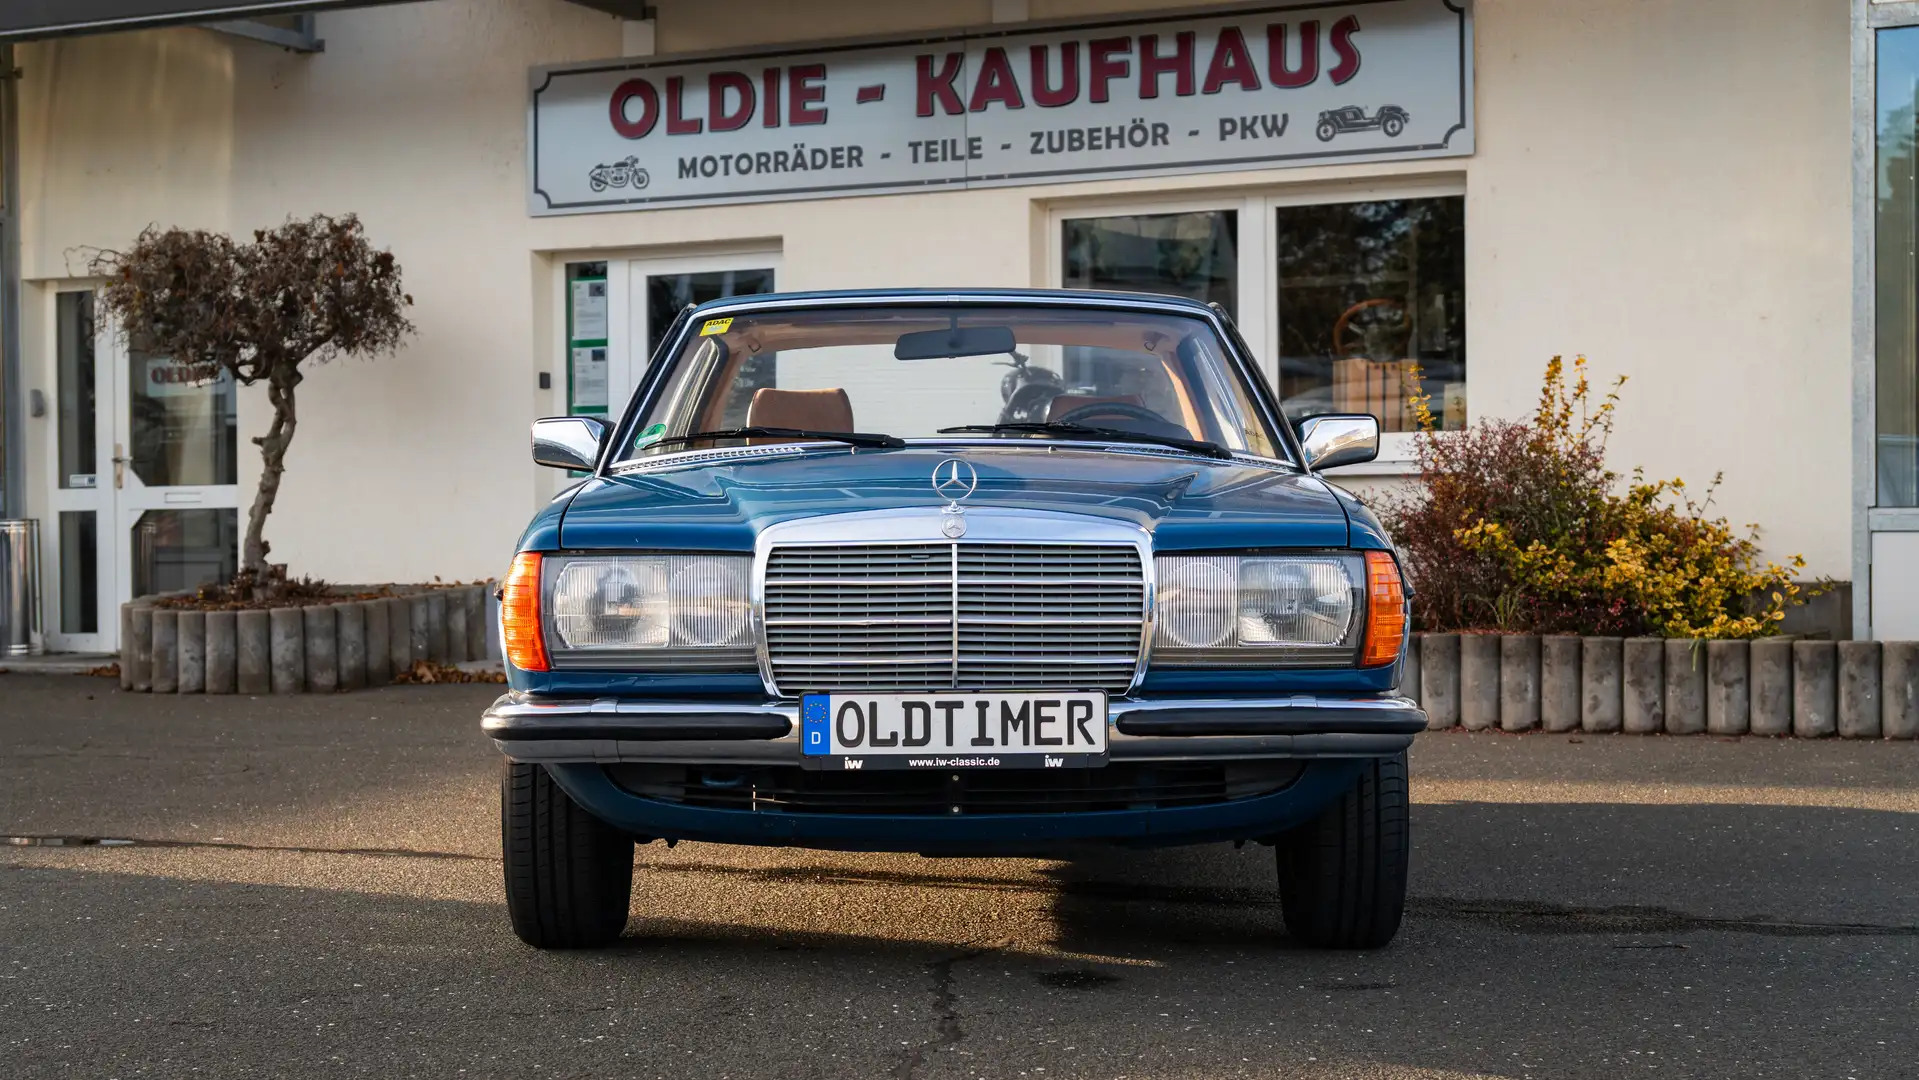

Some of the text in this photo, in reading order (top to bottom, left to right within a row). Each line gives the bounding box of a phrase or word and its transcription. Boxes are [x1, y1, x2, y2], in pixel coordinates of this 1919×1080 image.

[608, 62, 827, 140] OLDIE
[915, 14, 1361, 118] KAUFHAUS
[677, 144, 864, 180] MOTORRÄDER
[908, 136, 983, 165] TEILE
[1030, 117, 1170, 155] ZUBEHÖR
[1219, 113, 1289, 142] PKW
[836, 699, 1096, 748] OLDTIMER
[811, 731, 821, 745] D
[844, 756, 864, 770] iw
[908, 756, 1001, 767] www.iw-classic.de
[1044, 755, 1064, 768] iw
